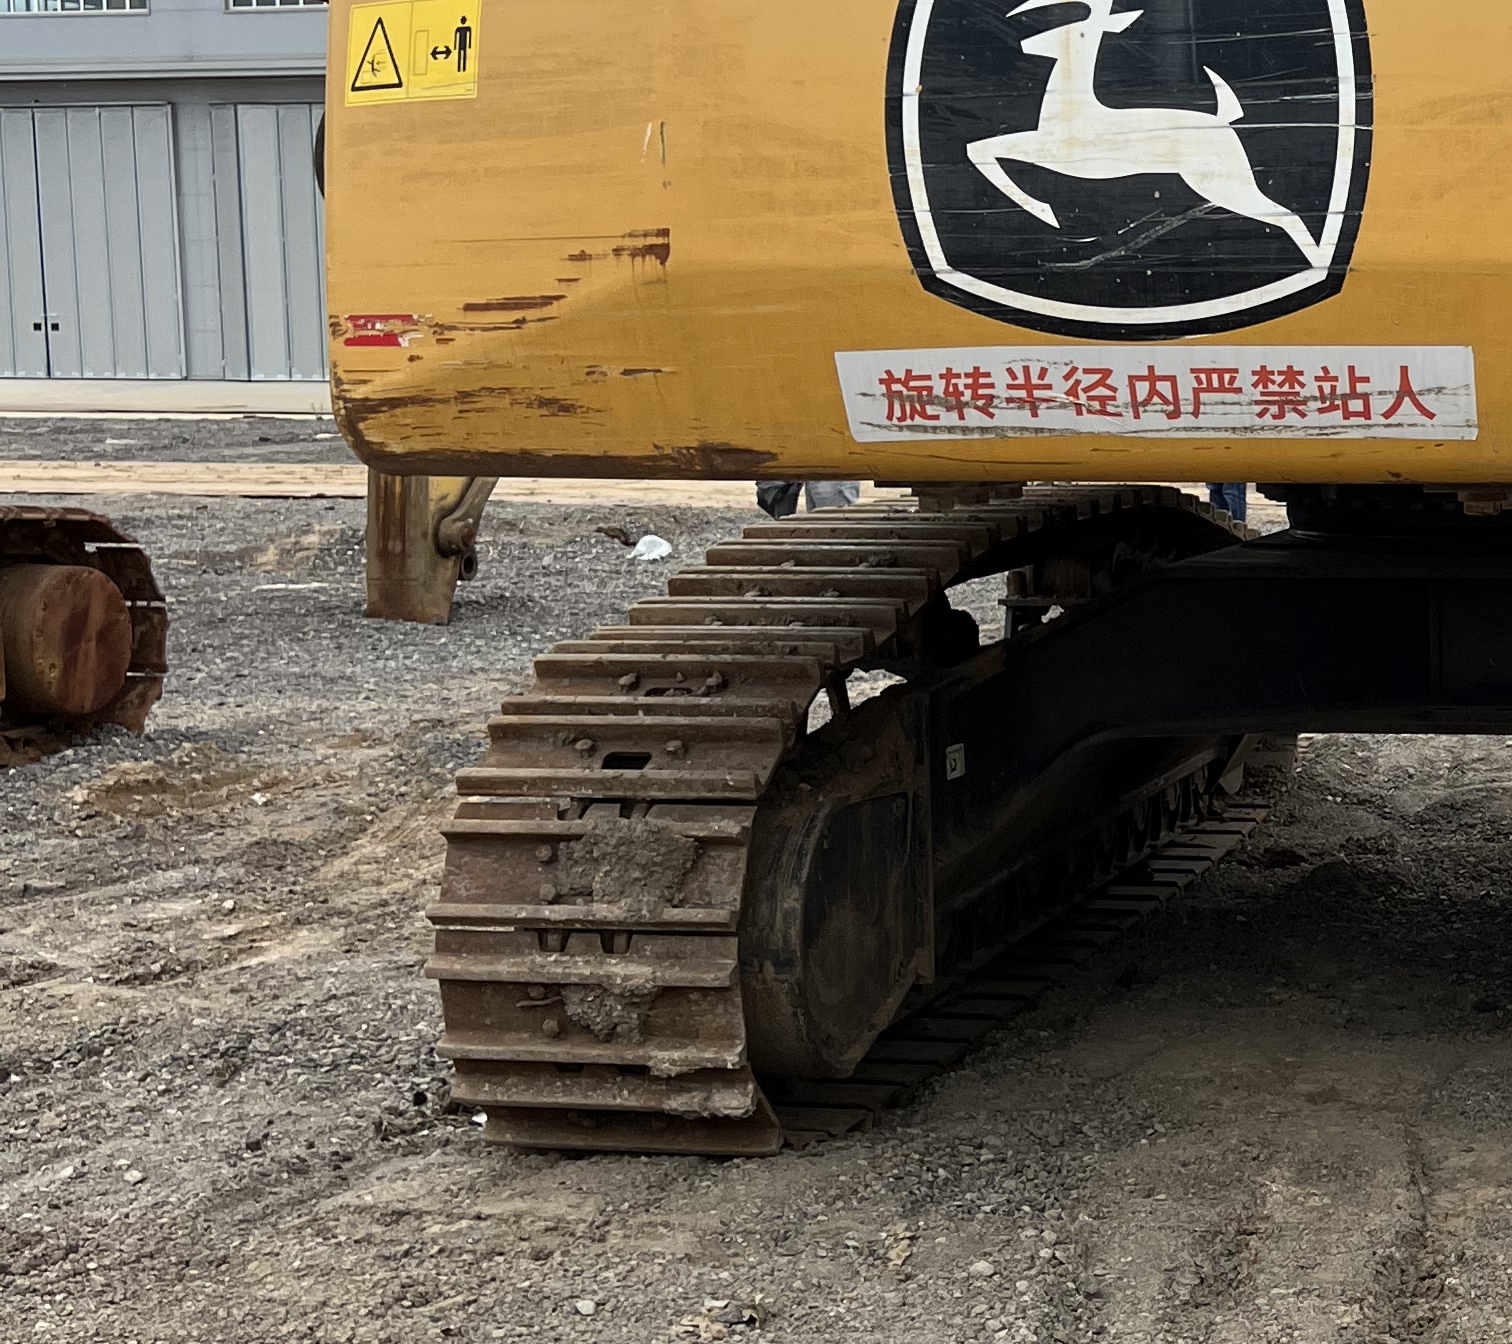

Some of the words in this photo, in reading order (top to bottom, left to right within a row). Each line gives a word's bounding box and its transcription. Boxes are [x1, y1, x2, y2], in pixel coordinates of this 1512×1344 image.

[878, 364, 1437, 422] 旋转半径内严禁站人
